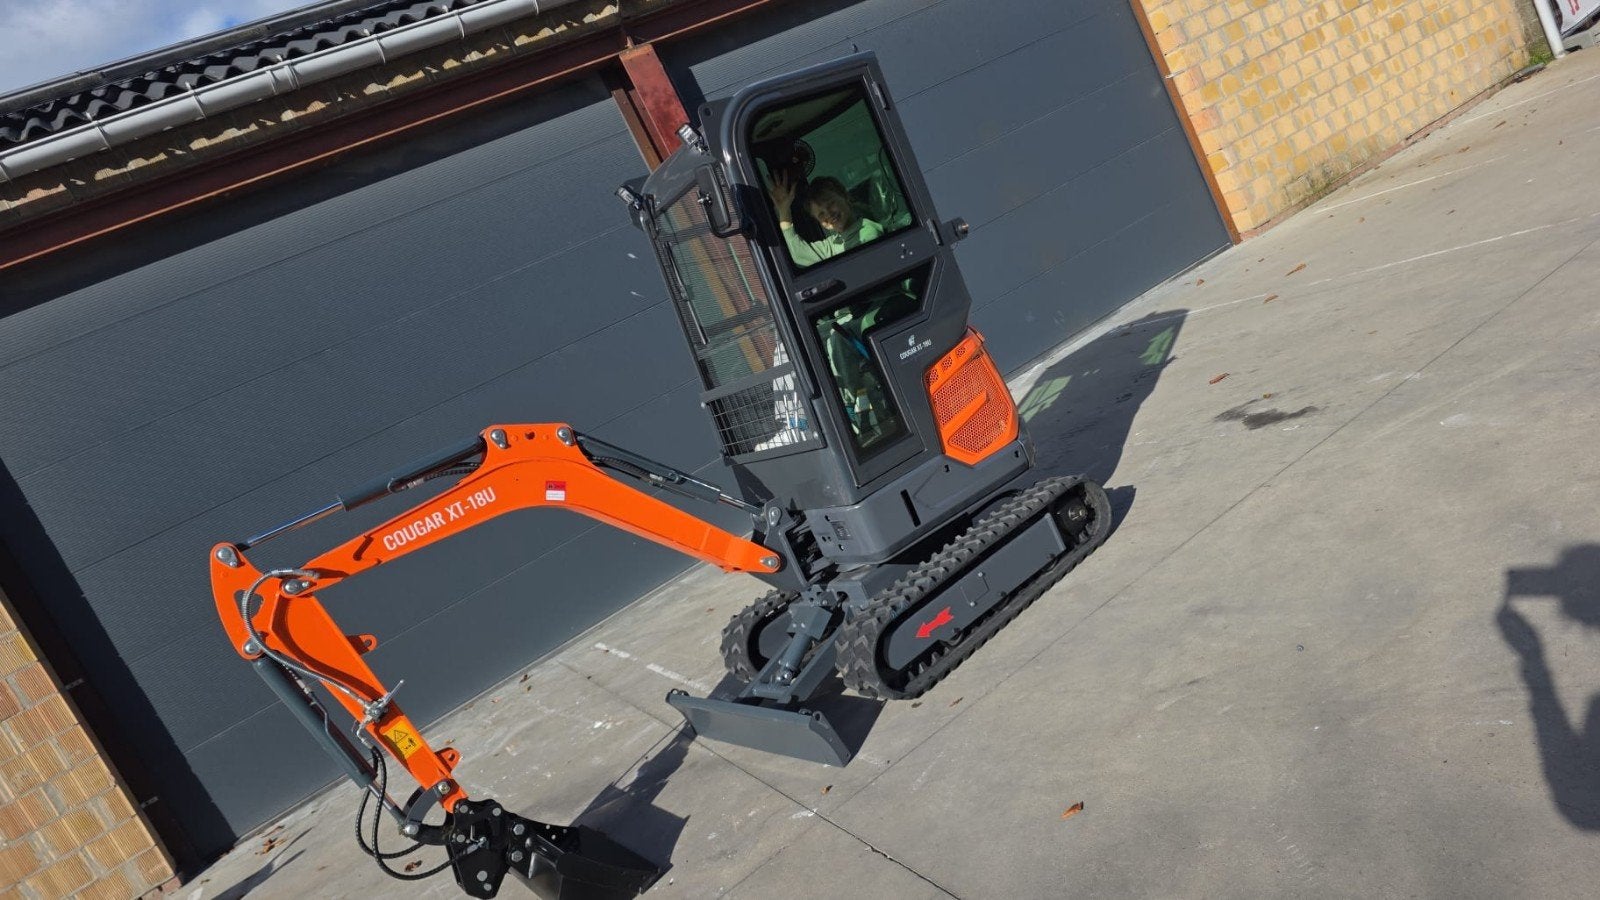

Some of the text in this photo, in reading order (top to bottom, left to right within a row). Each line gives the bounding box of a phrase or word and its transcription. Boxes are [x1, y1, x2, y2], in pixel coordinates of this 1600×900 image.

[900, 346, 917, 360] COUGAR
[383, 486, 497, 551] COUGAR XT-18U
